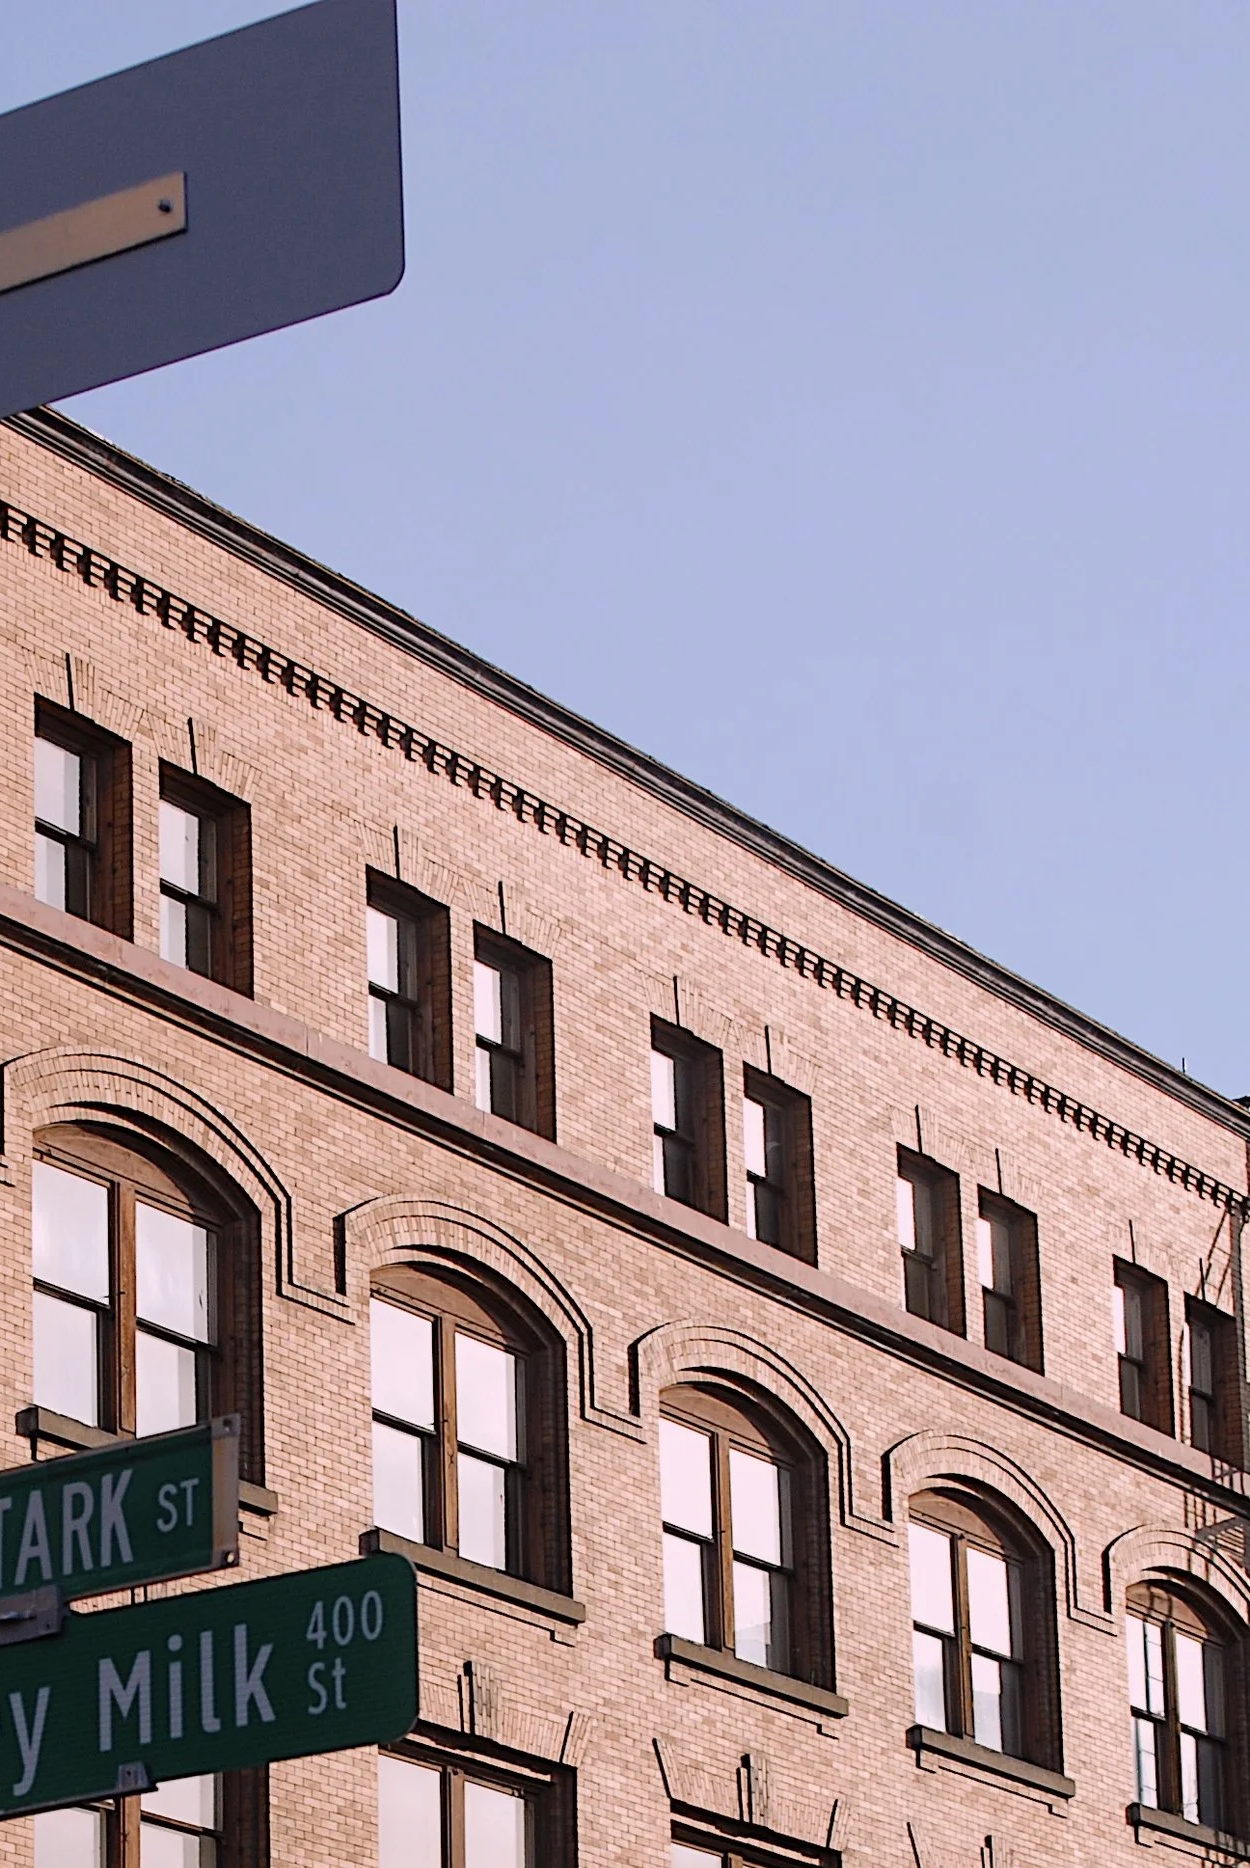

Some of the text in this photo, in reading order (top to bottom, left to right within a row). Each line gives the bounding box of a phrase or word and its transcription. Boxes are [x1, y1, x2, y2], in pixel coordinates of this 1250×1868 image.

[157, 1478, 200, 1534] ST
[306, 1590, 383, 1649] 400
[98, 1623, 277, 1752] Milk
[307, 1656, 347, 1716] St
